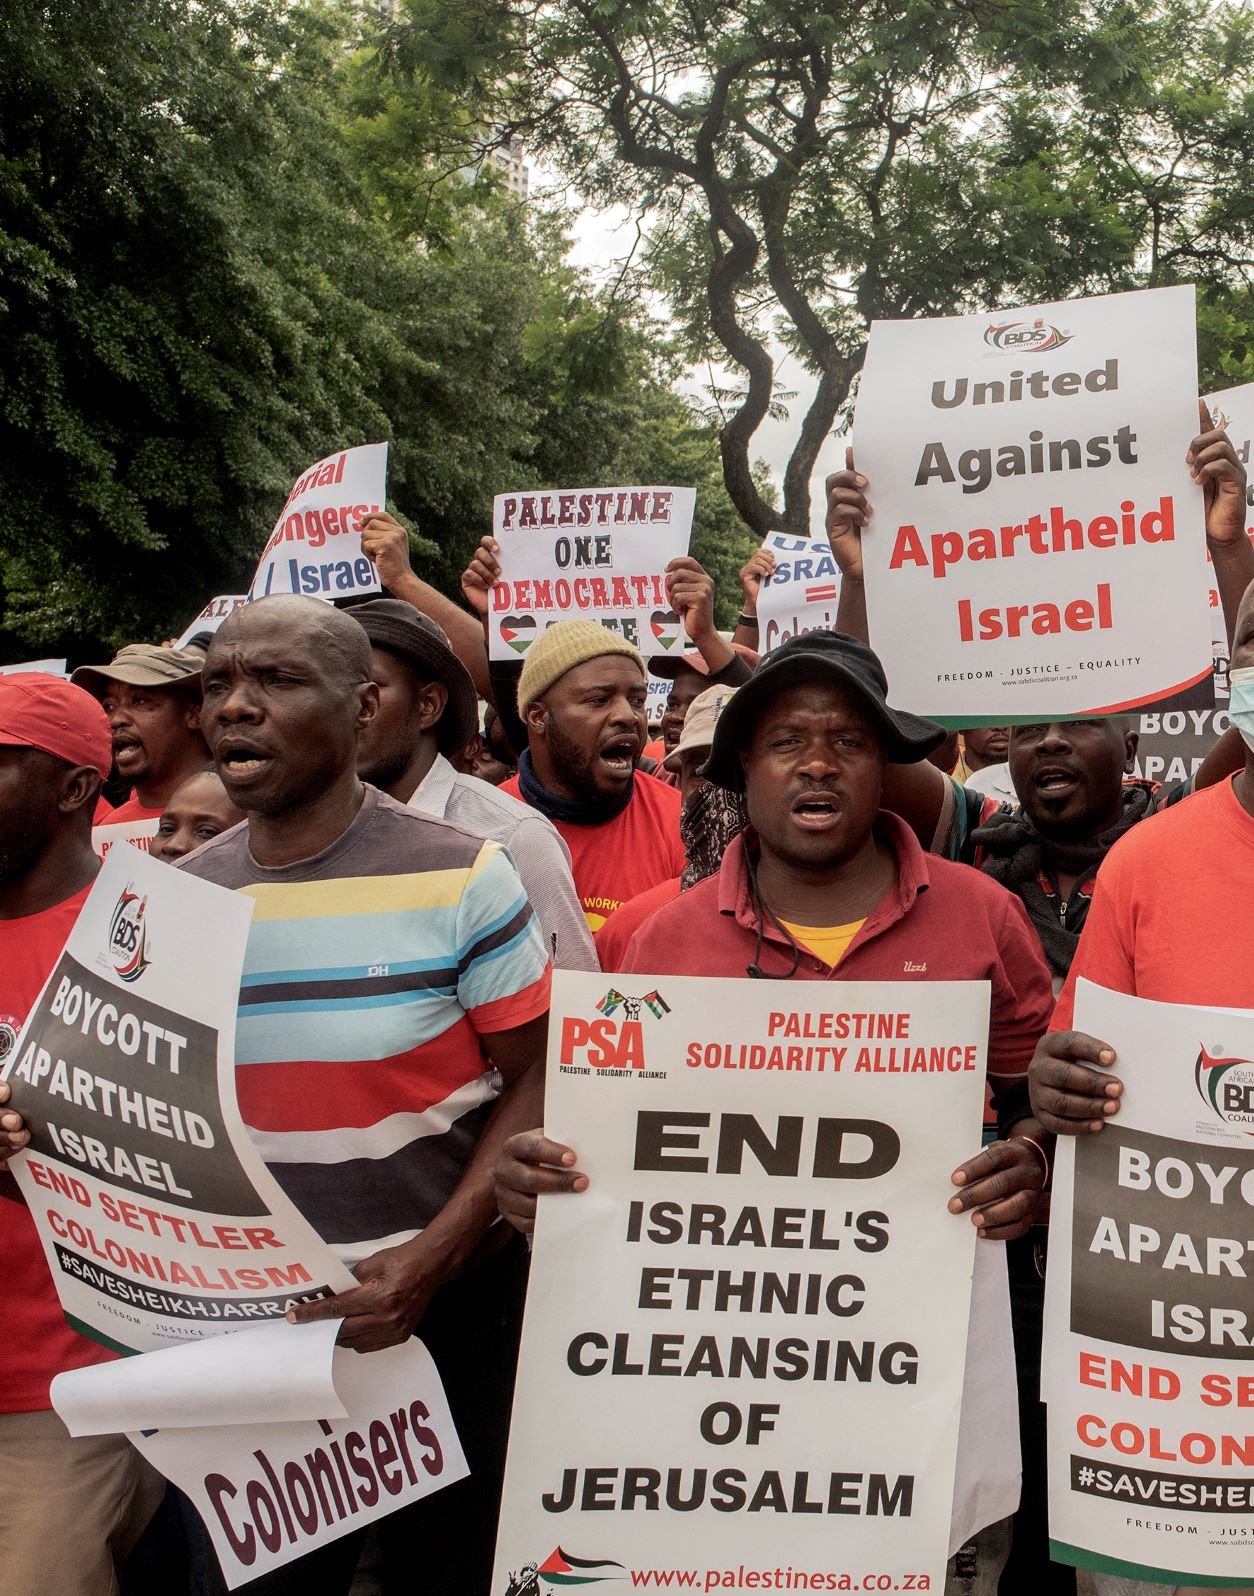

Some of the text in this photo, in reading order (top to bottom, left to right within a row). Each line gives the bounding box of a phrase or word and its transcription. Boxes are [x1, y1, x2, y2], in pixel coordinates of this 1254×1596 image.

[1004, 329, 1046, 345] BDS
[931, 359, 1119, 409] United
[914, 425, 1138, 494] Against
[503, 492, 673, 531] PALESTINE
[889, 496, 1175, 578] Apartheid
[555, 534, 613, 570] ONE
[957, 583, 1113, 642] Israel
[937, 657, 1142, 683] FREEDOM JUSTICE EQUALITY
[113, 917, 140, 952] BDS
[50, 975, 188, 1074] BOYCOTT
[559, 1017, 645, 1069] PSA
[768, 1012, 911, 1039] PALESTINE
[559, 1065, 667, 1080] PALESTINE SOLIDARITY ALLIANCE
[685, 1043, 977, 1073] SOLIDARITY ALLIANCE
[15, 1041, 216, 1149] APARTHEID
[47, 1123, 193, 1199] ISRAEL
[633, 1110, 901, 1180] END
[26, 1159, 286, 1251] END SETTLER
[625, 1201, 890, 1253] ISRAEL'S
[47, 1209, 314, 1292] COLONIALISM
[638, 1267, 866, 1318] ETHNIC
[97, 1301, 141, 1325] FREEDOM
[155, 1323, 205, 1336] JUSTICE
[566, 1332, 918, 1385] CLEANSING
[1079, 1351, 1180, 1402] END
[699, 1401, 780, 1446] OF
[204, 1399, 444, 1567] Colonisers
[541, 1467, 915, 1518] JERUSALEM
[1126, 1517, 1198, 1535] FREEDOM
[630, 1564, 931, 1594] www.palestinesa.co.za
